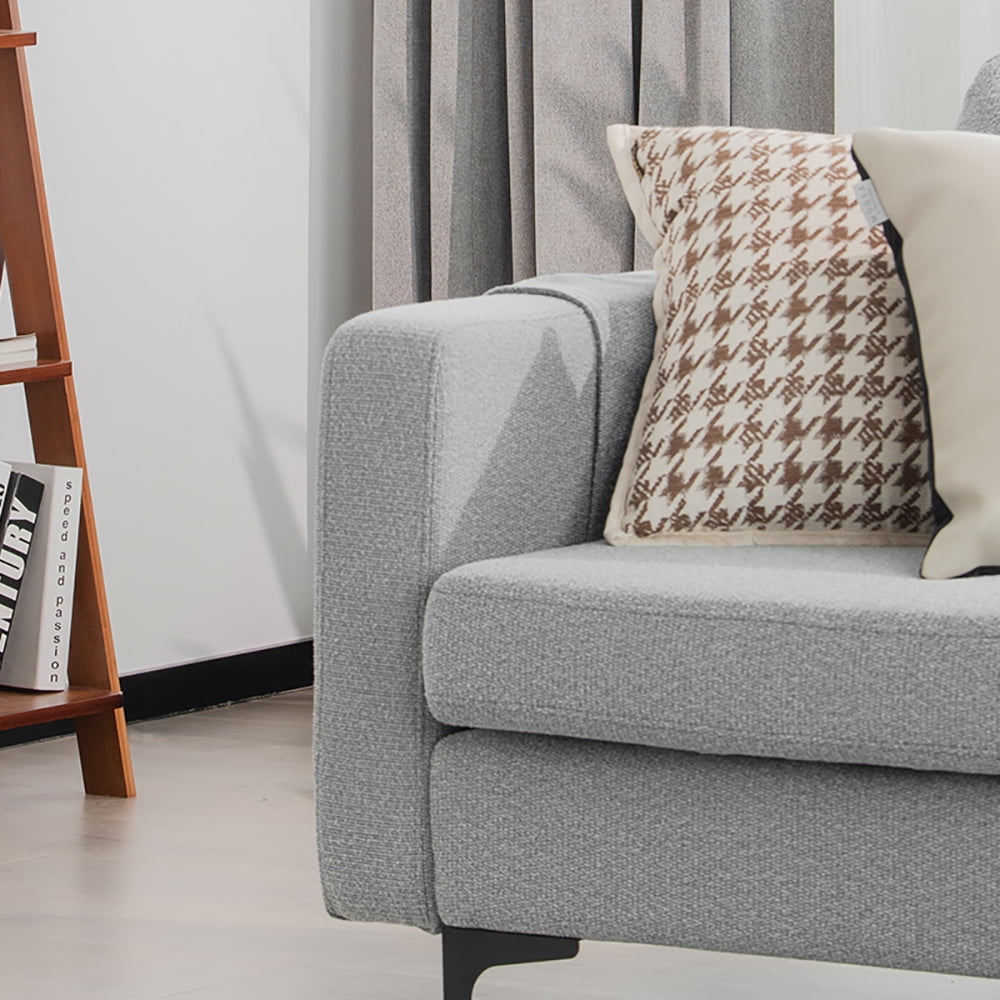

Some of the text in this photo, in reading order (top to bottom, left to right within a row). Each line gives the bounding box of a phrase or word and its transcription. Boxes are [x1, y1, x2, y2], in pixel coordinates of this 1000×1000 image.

[50, 481, 73, 683] speed and passion
